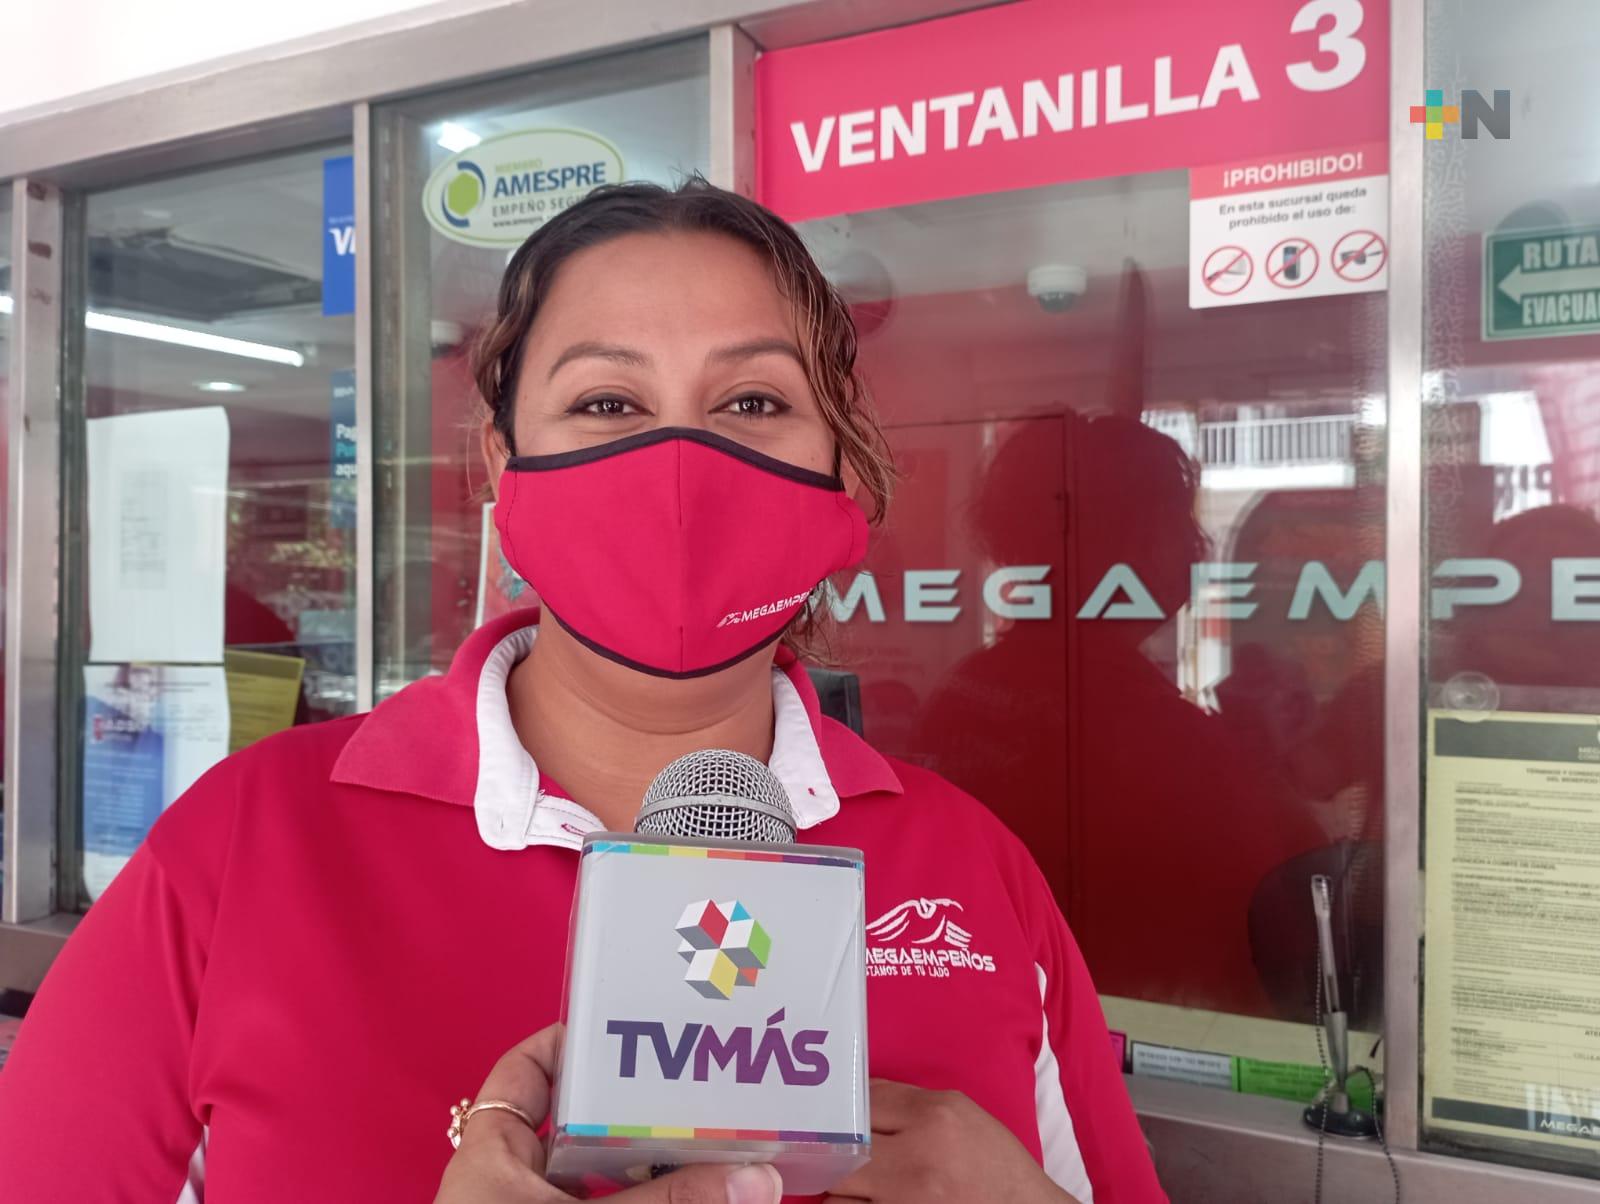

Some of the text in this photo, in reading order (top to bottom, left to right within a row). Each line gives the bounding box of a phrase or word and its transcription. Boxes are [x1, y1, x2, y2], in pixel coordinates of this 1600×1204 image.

[790, 0, 1367, 173] VENTANILLA 3
[493, 161, 607, 198] AMESPRE
[1223, 151, 1363, 188] ¡PROHIBIDO!
[492, 199, 546, 218] EMPEÑO
[1219, 187, 1368, 216] En esta sucursal queda
[1229, 203, 1356, 231] prohibido el uso de:
[1522, 235, 1600, 270] RUTA
[1522, 291, 1600, 326] EVACUA
[741, 588, 812, 623] MEGAEMPE
[901, 965, 913, 977] DE
[915, 965, 926, 977] TU
[929, 965, 950, 978] LADO
[606, 1005, 830, 1087] TVMÁS
